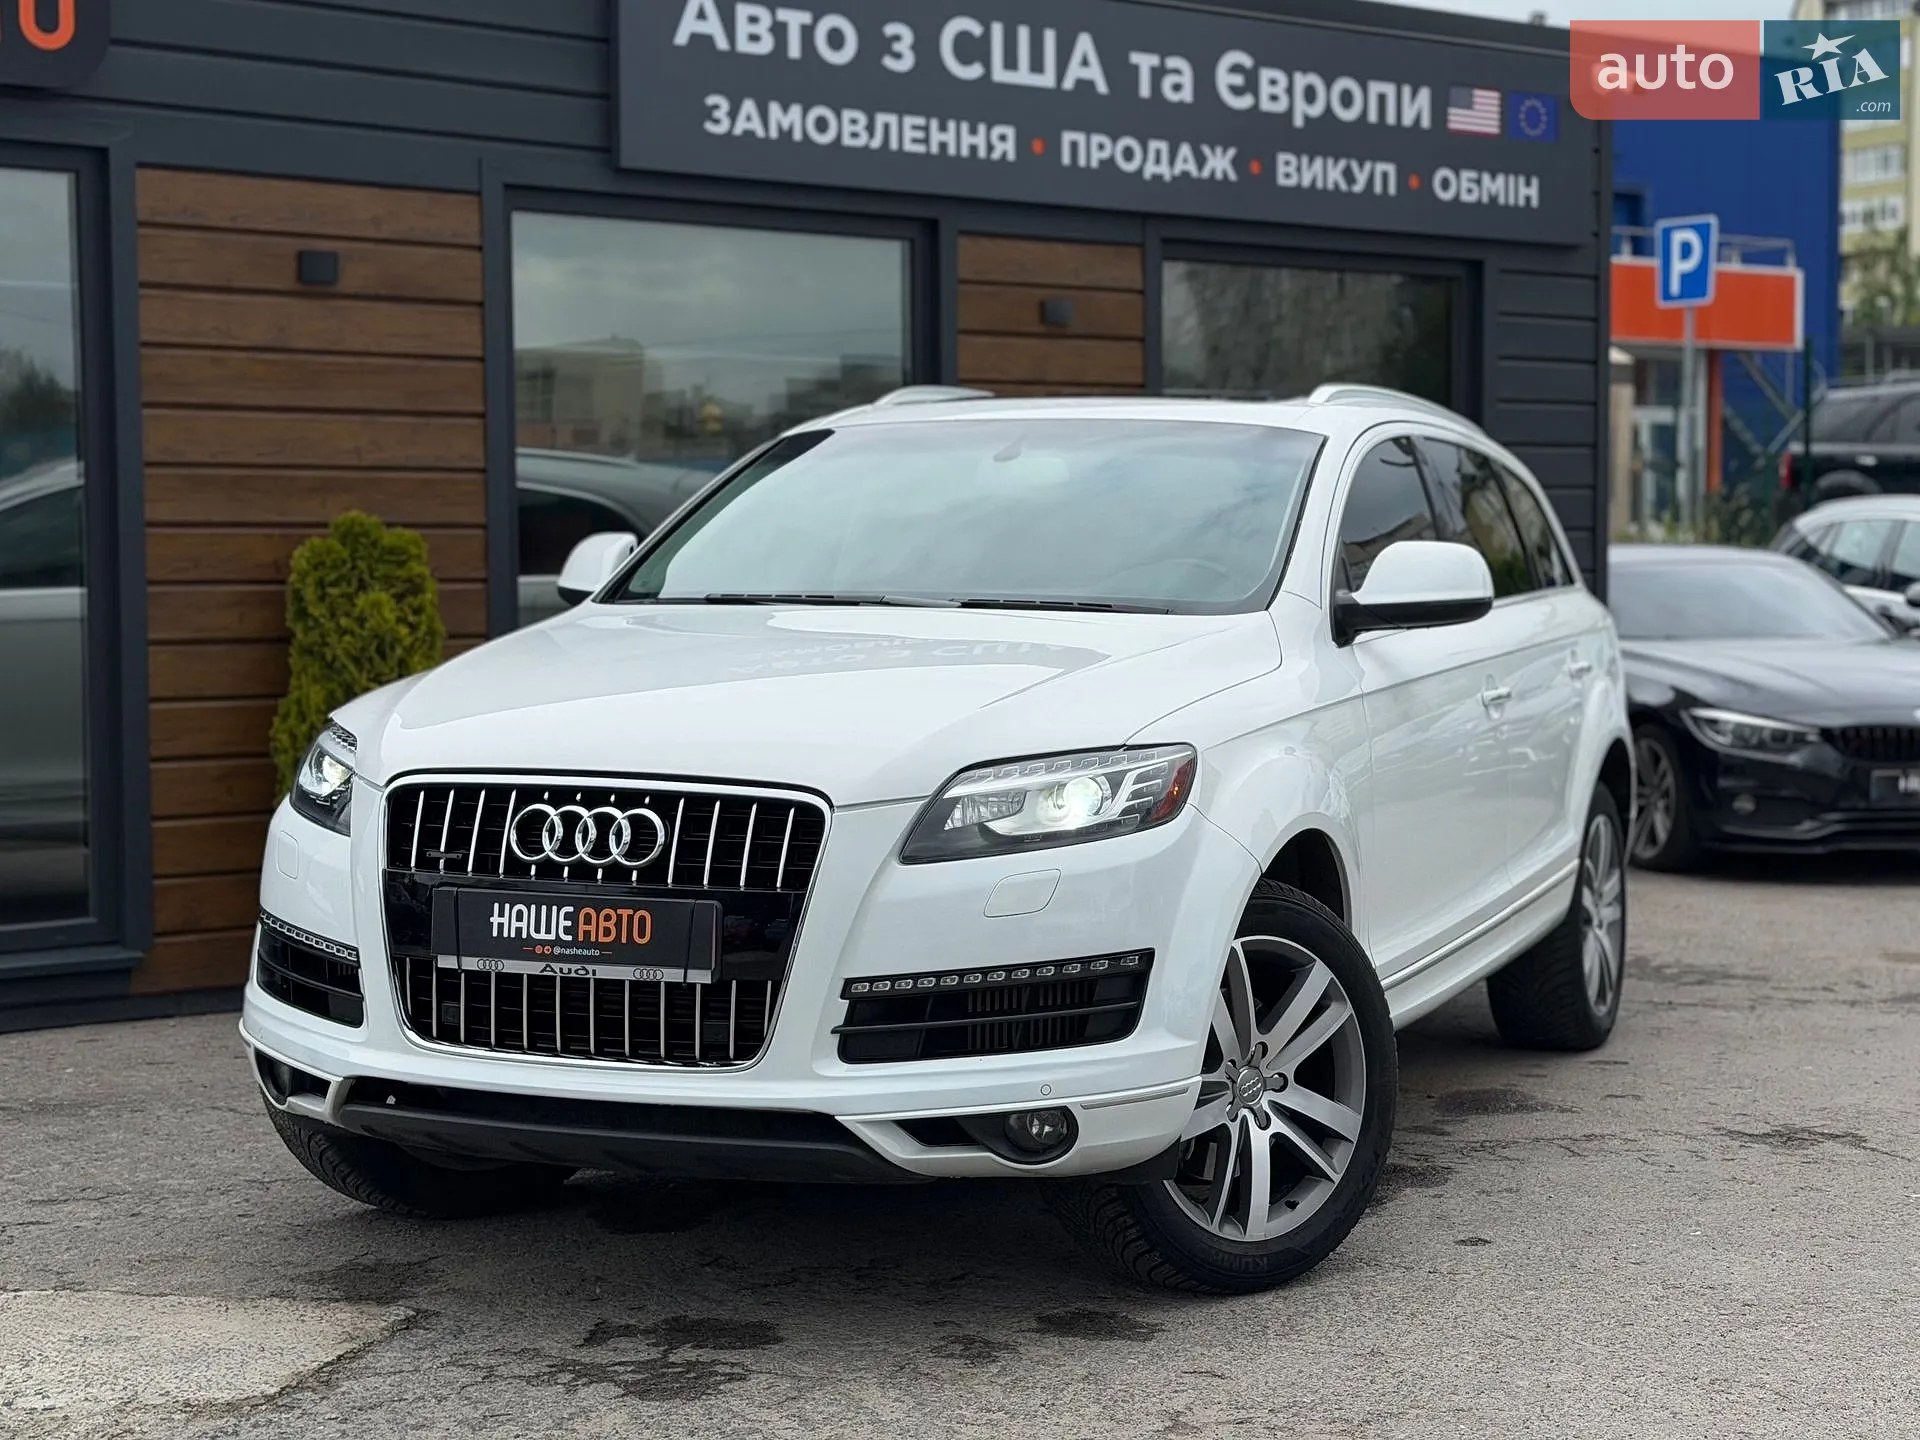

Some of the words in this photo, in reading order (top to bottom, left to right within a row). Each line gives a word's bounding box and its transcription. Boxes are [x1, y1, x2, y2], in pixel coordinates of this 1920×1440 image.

[672, 0, 860, 66] Авто
[881, 21, 916, 73] з
[939, 15, 1110, 95] США
[1128, 51, 1194, 104] та
[1215, 49, 1431, 129] Європи
[703, 94, 1017, 162] ЗАМОВЛЕННЯ
[1060, 130, 1237, 182] ПРОДАЖ
[1276, 152, 1397, 196] ВИКУП
[1432, 167, 1540, 208] ОБМІН
[1668, 227, 1703, 297] P
[539, 963, 598, 977] Audi
